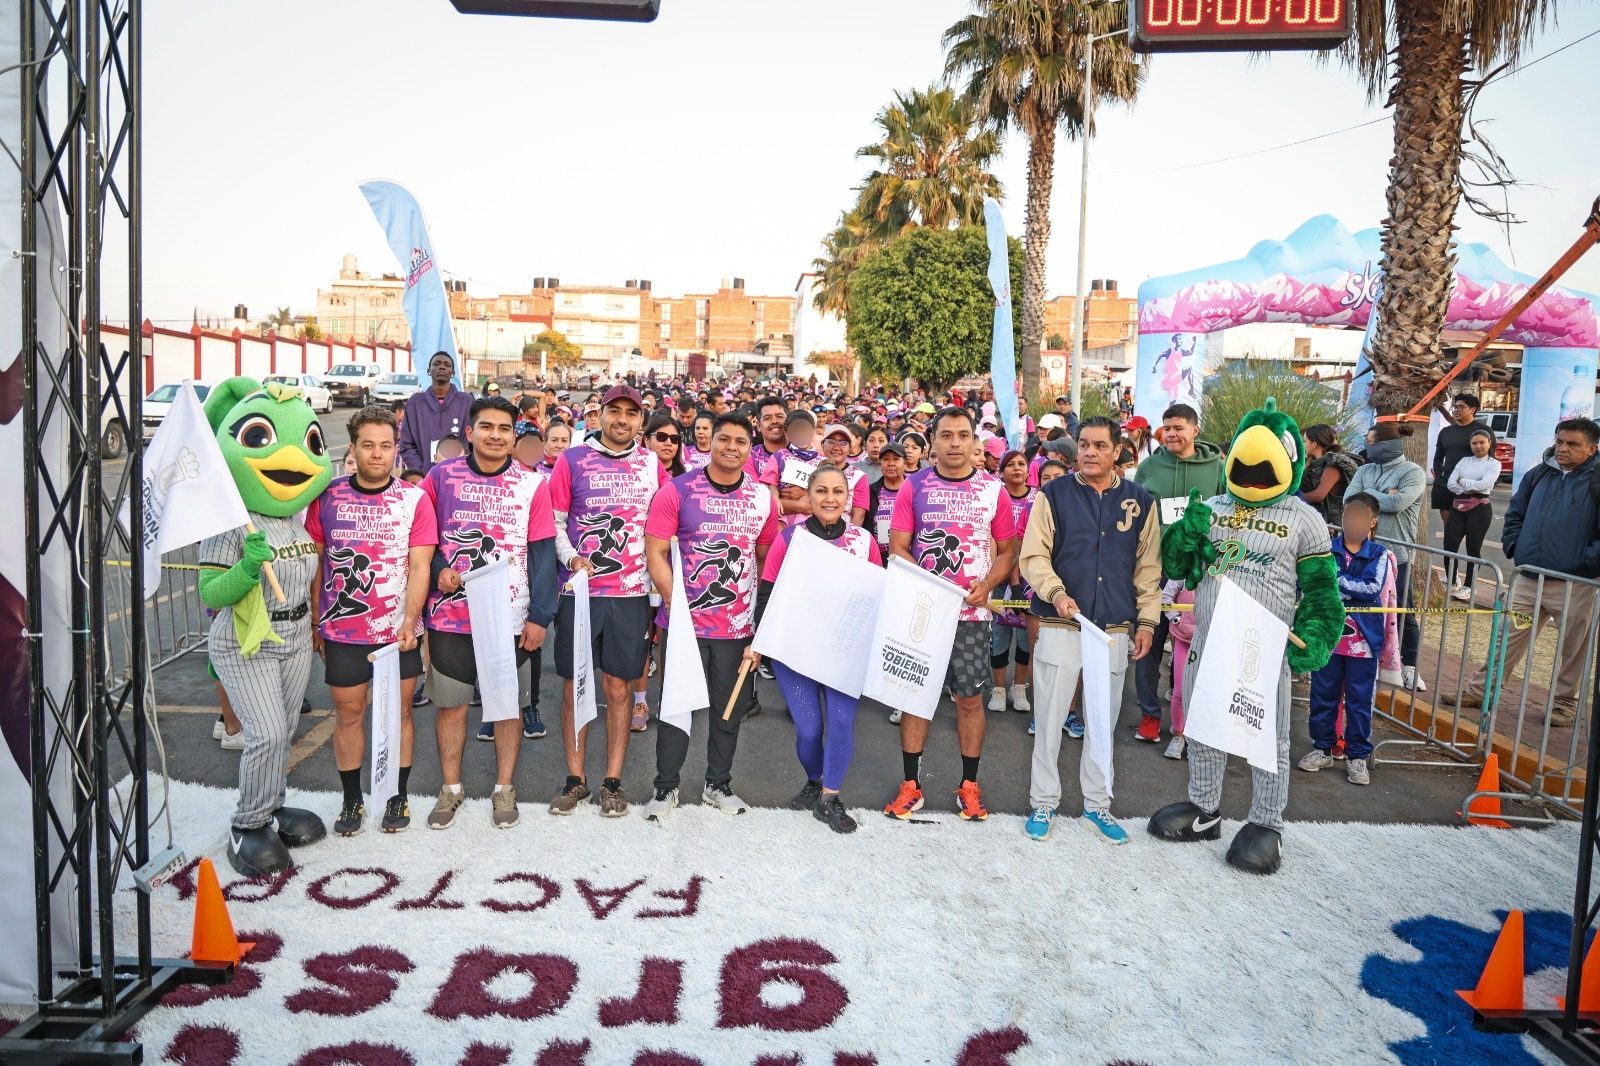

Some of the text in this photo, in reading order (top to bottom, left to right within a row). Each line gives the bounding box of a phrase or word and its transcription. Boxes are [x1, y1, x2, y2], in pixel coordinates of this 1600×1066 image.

[591, 474, 641, 482] CARRERA
[796, 470, 811, 482] 73
[462, 484, 515, 498] CARRERA
[929, 490, 980, 502] CARRERA
[338, 504, 392, 516] CARRERA
[481, 496, 514, 512] Mujer
[706, 498, 757, 510] CARRERA
[947, 499, 981, 515] Mujer
[357, 516, 392, 532] Mujer
[454, 512, 517, 525] CUAUTLANCINGO
[922, 513, 984, 524] CUAUTLANCINGO
[331, 530, 396, 541] CUAUTLANCINGO
[1228, 564, 1267, 579] ente.mx
[882, 661, 925, 687] UNICIPAL
